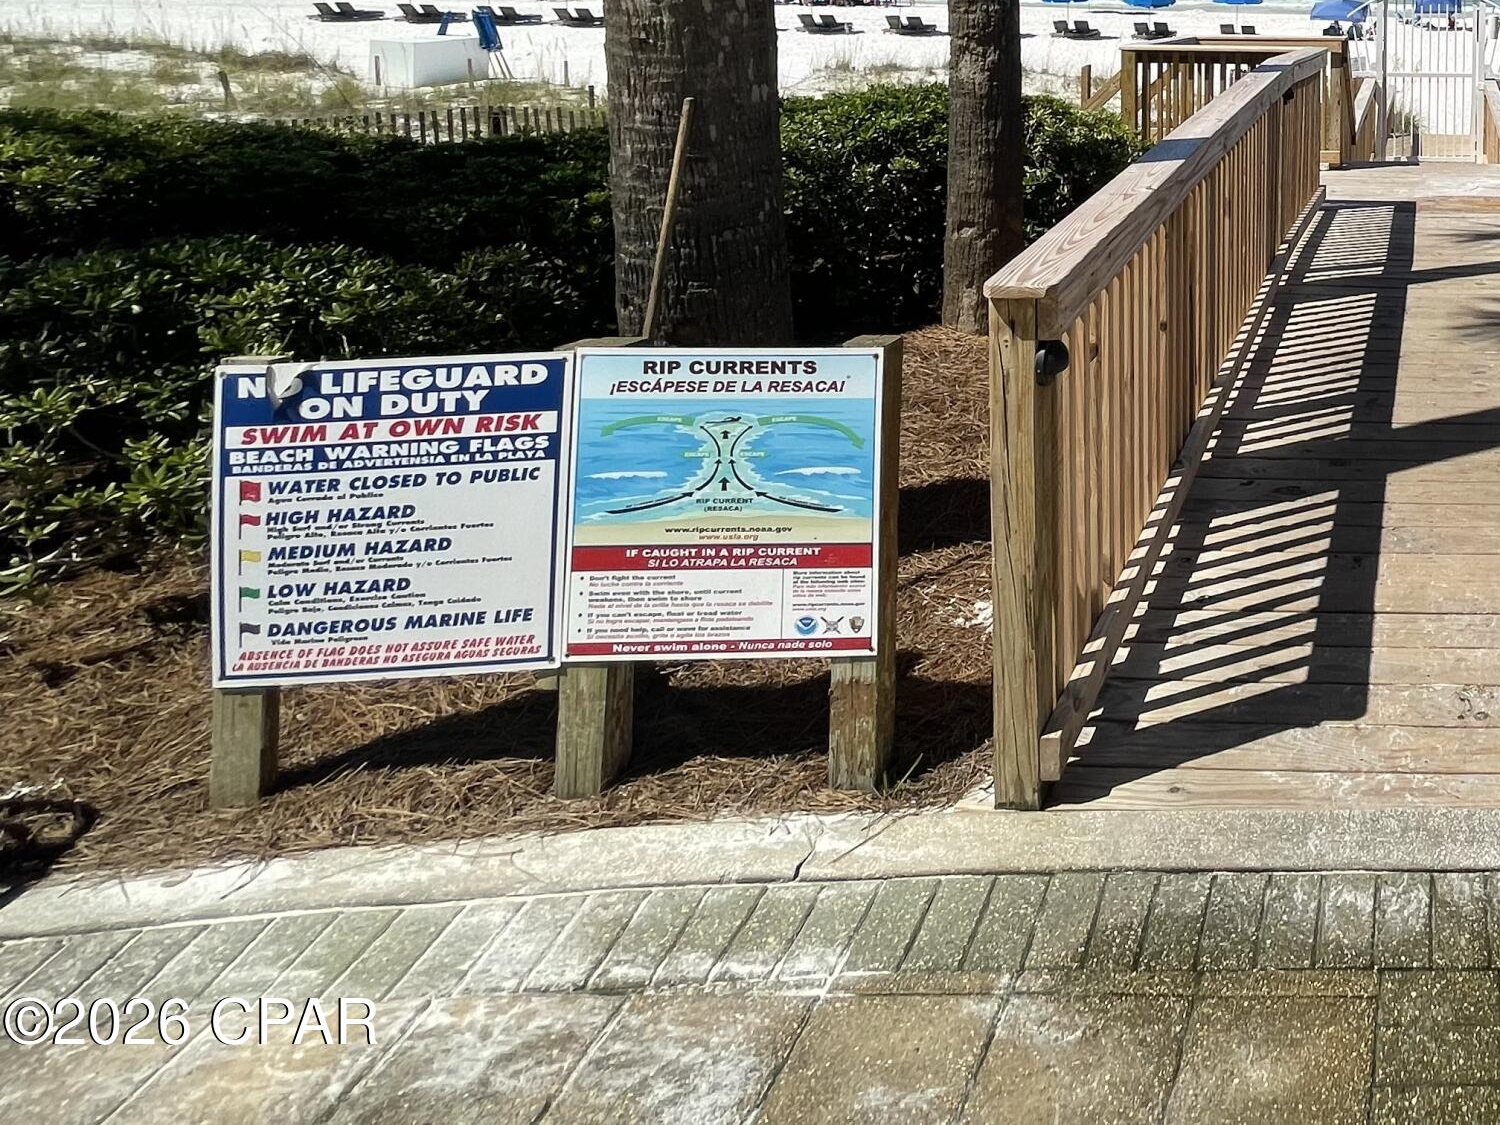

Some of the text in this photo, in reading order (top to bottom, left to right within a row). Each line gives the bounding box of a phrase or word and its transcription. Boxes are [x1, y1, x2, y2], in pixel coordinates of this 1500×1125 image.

[321, 364, 548, 394] LIFEGUARD
[643, 360, 817, 375] RIP CURRENTS
[609, 378, 709, 395] ¡ESCÁPESE
[713, 381, 737, 392] DE
[741, 381, 762, 392] LA
[299, 389, 490, 419] ON DUTY
[241, 413, 542, 445] SWIM AT OWN RISK
[229, 435, 549, 465] BEACH WARNING FLAGS
[232, 450, 545, 474] BANDERAS DE ADVERTENSIA EN LA PLAYA
[268, 467, 540, 495] WATER CLOSED TO PUBLIC
[266, 504, 416, 525] HIGH HAZARD
[665, 526, 792, 534] www.ripcurrents.noaa.gov
[268, 537, 452, 561] MEDIUM HAZARD
[626, 547, 821, 557] IF CAUGHT IN A RIP CURRENT
[647, 558, 798, 567] SI LO ATRAPA LA RESACA
[267, 578, 411, 599] LOW HAZARD
[267, 608, 533, 637] DANGEROUS MARINE LIFE
[232, 645, 542, 671] LA AUSENCIA DE BANDERAS NO ASEGURA AGUAS SEGURAS
[239, 634, 535, 661] ABSENCE OF FLAG DOES NOT ASSURE SAFE WATER
[613, 644, 651, 652] Never
[653, 643, 687, 651] swim
[691, 643, 727, 651] alone
[777, 641, 805, 649] nade
[808, 640, 832, 648] solo
